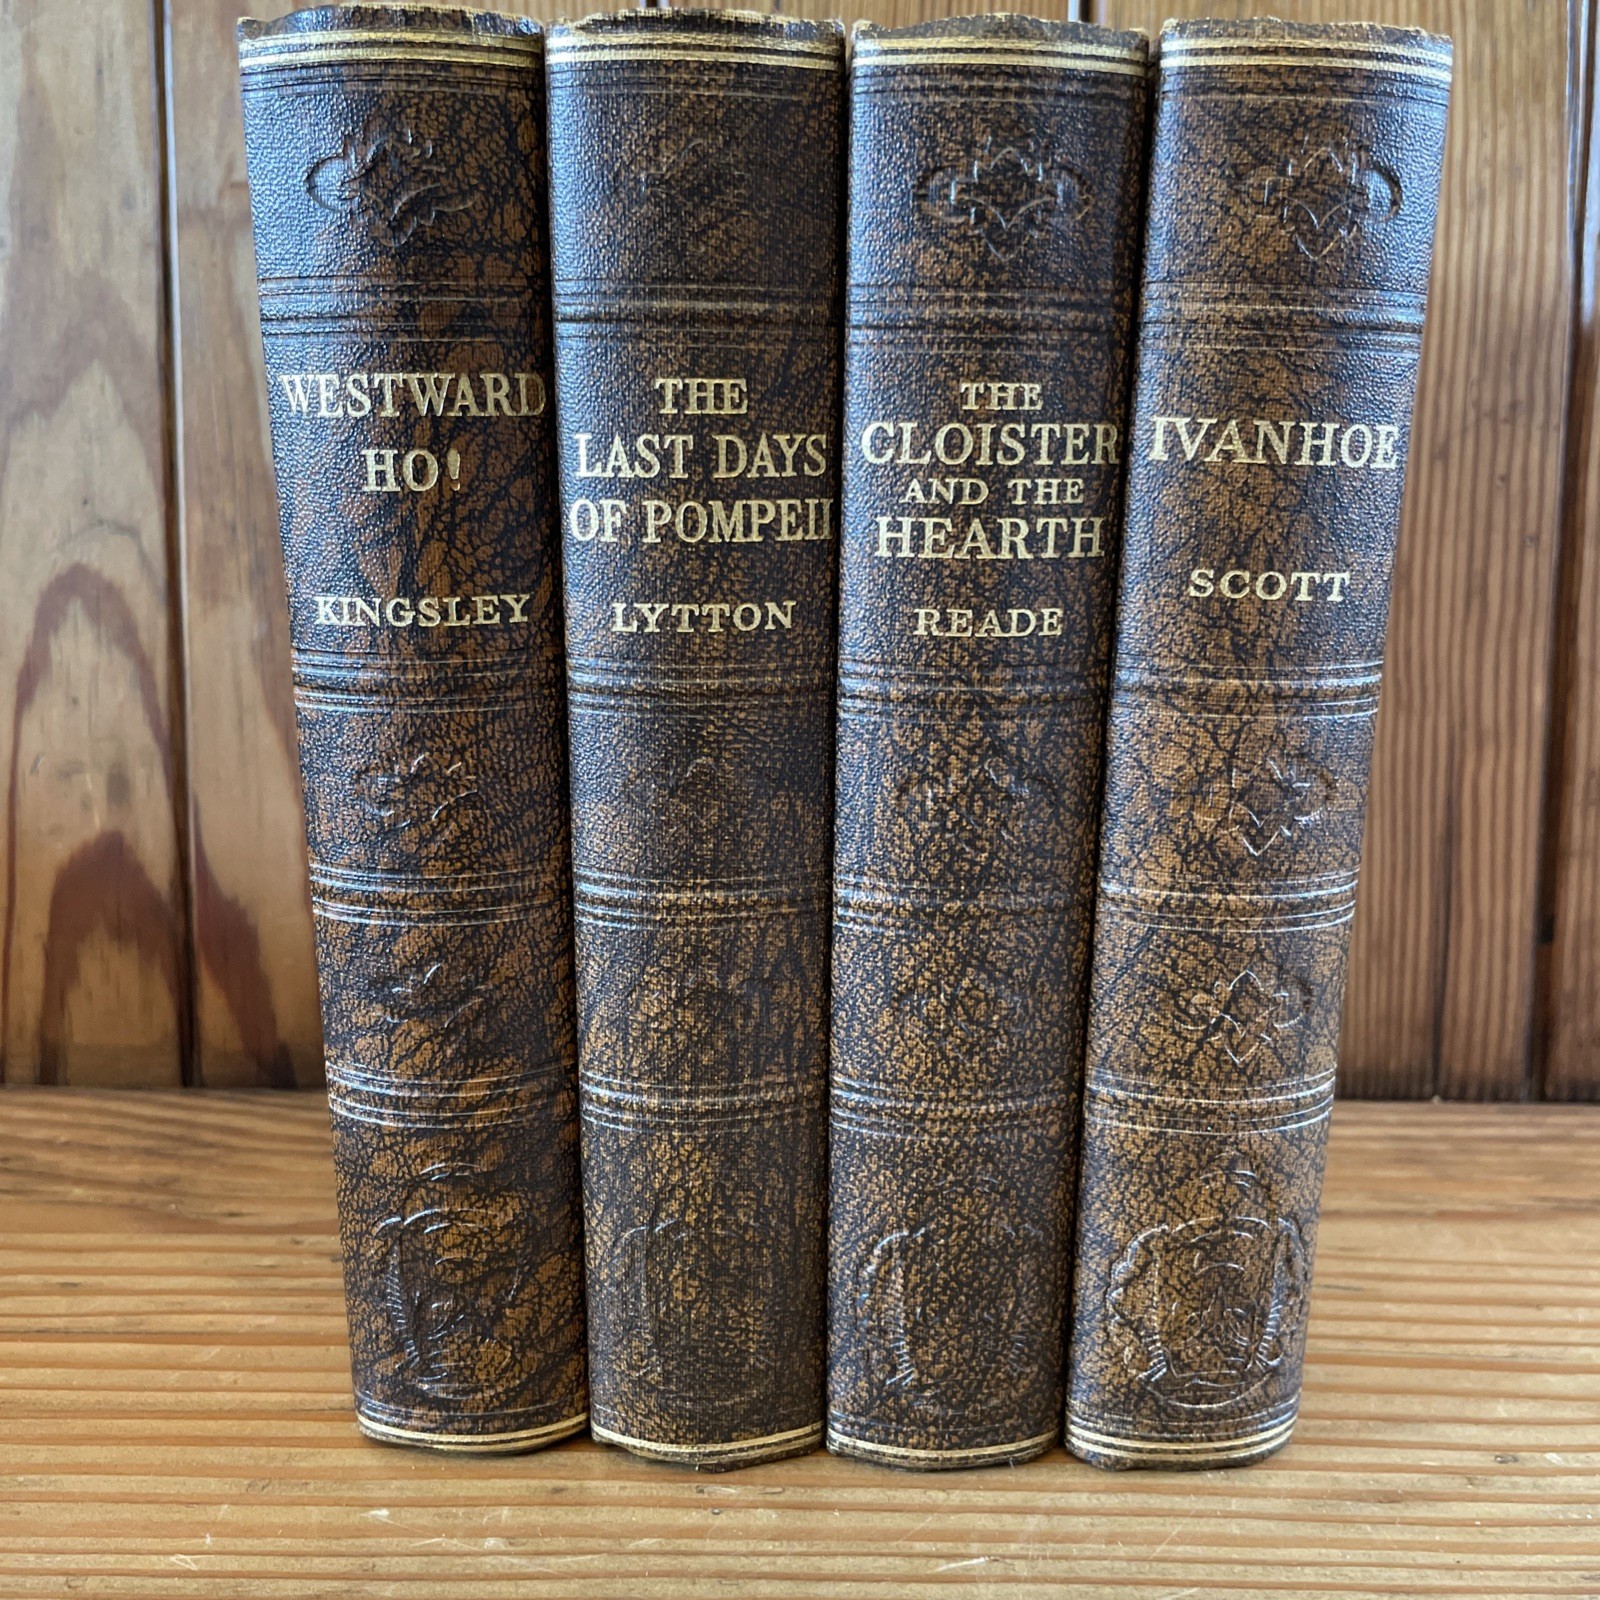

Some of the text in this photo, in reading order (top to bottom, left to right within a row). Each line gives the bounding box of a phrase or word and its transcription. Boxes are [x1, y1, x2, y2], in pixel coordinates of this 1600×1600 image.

[279, 371, 547, 420] WESTWARD
[655, 377, 749, 416] THE
[960, 382, 1044, 411] THE
[574, 432, 828, 479] LAST DAYS
[861, 422, 1121, 466] CLOISTER
[1148, 415, 1399, 470] IVANHOE
[361, 448, 461, 493] HO!
[899, 477, 1085, 505] AND THE
[569, 498, 835, 543] OF POMPEII
[874, 516, 1106, 560] HEARTH
[1188, 568, 1350, 603] SCOTT
[313, 594, 531, 628] KINGSLEY
[611, 600, 797, 633] LYTTON
[912, 608, 1065, 638] READE
